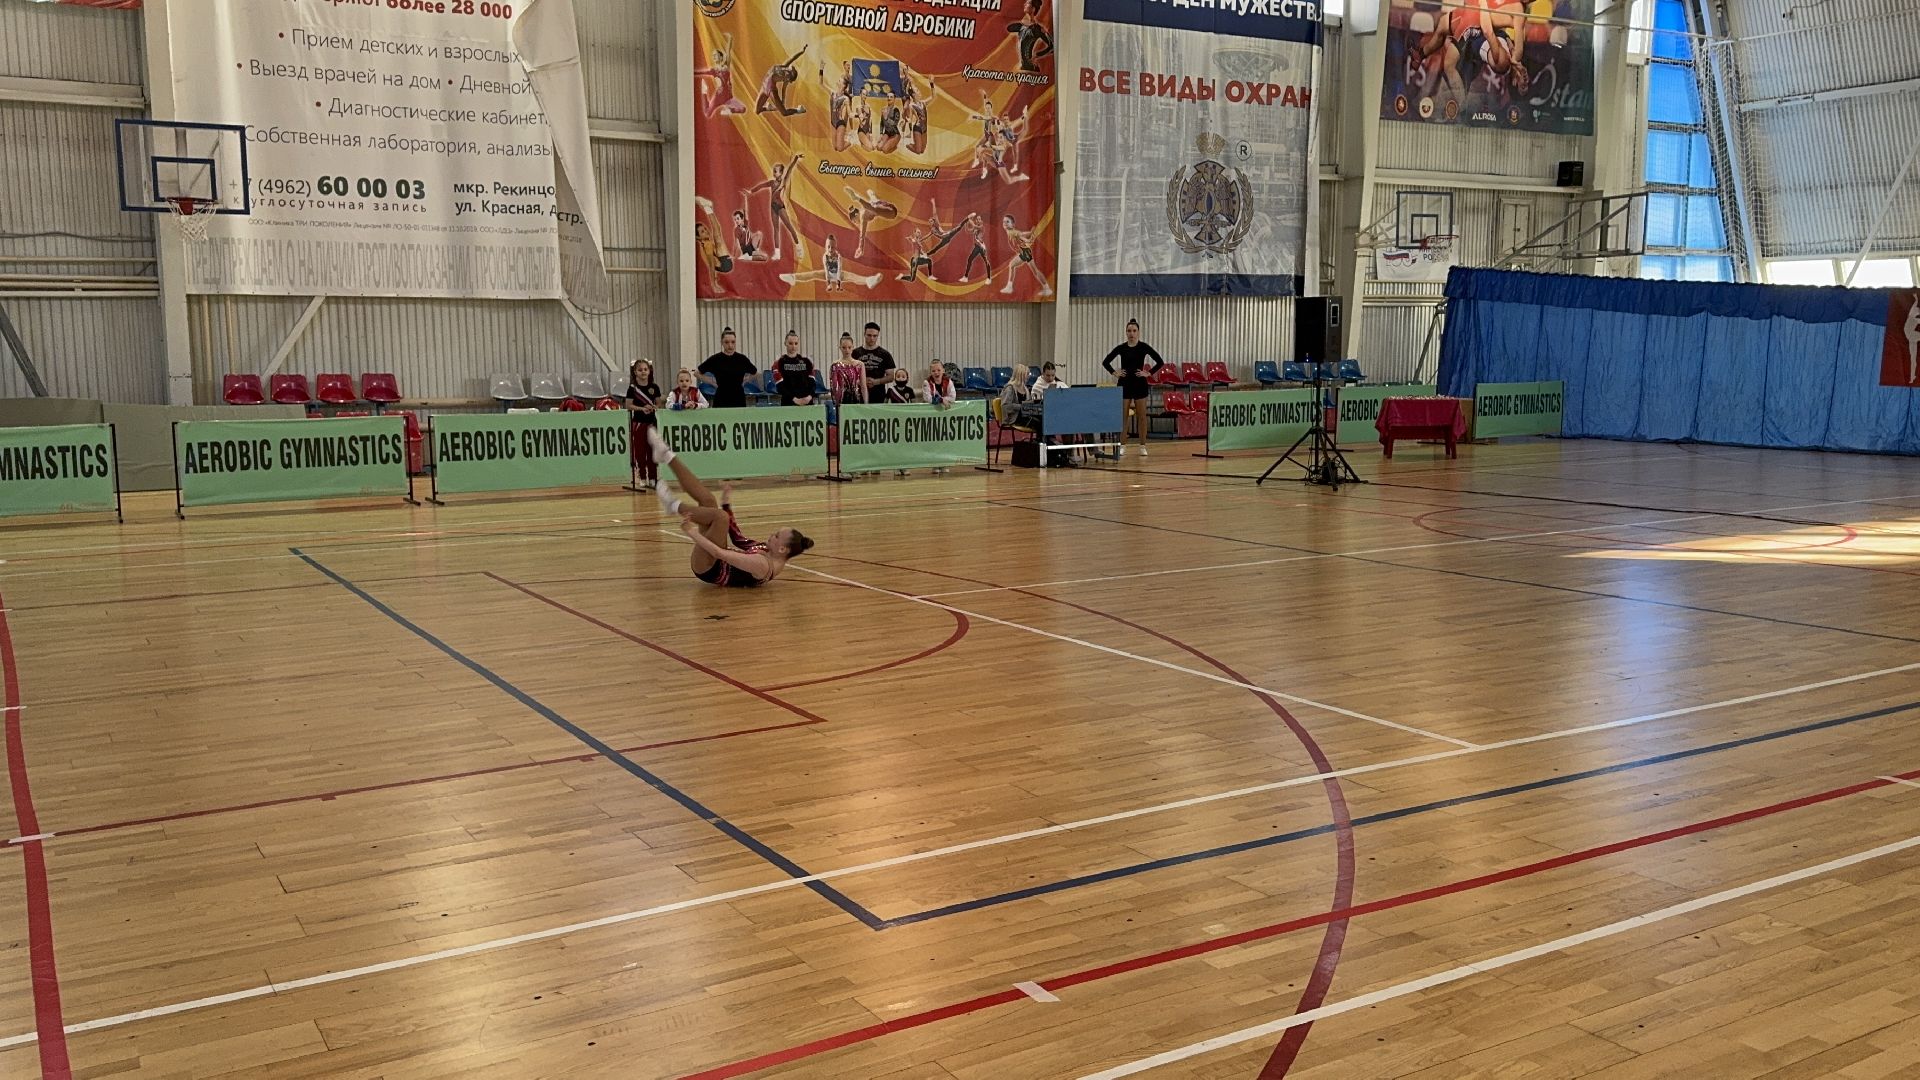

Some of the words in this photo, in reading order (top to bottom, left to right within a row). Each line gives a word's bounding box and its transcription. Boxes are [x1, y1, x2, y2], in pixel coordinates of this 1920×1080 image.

[452, 0, 475, 15] 28
[481, 1, 512, 19] 000
[782, 0, 887, 32] СПОРТИВНОЙ
[893, 12, 976, 40] АЭРОБИКИ
[1220, 0, 1322, 21] МУЖЕСТВ
[292, 28, 353, 50] Прием
[360, 39, 423, 57] детских
[428, 46, 438, 58] и
[444, 46, 520, 63] взрослых
[250, 59, 309, 81] Выезд
[315, 67, 377, 85] врачей
[383, 73, 403, 87] на
[409, 75, 441, 90] дом
[460, 75, 531, 95] Дневной
[963, 64, 1004, 81] Красота
[1006, 72, 1014, 82] и
[1015, 73, 1049, 86] грация
[1079, 67, 1131, 95] ВСЕ
[1139, 72, 1216, 104] ВИДЫ
[328, 97, 476, 123] Диагностические
[245, 125, 361, 148] Собственная
[368, 134, 480, 157] лаборатория,
[487, 142, 553, 157] анализы
[898, 165, 940, 179] сильнее!
[258, 178, 311, 197] (4962)
[317, 176, 349, 197] 60
[357, 177, 388, 199] 00
[395, 179, 426, 200] 03
[454, 183, 488, 198] мкр.
[494, 181, 556, 198] Рекинцо
[373, 201, 427, 213] запись
[455, 201, 476, 216] ул.
[482, 199, 544, 216] Красная,
[1211, 403, 1256, 428] AEROBIC
[1340, 399, 1379, 422] AEROBIC
[1478, 394, 1512, 416] AEROBIC
[1513, 392, 1561, 415] GYMNASTICS
[662, 423, 727, 453] AEROBIC
[733, 420, 824, 451] GYMNASTICS
[842, 417, 900, 445] AEROBIC
[905, 415, 984, 443] GYMNASTICS
[185, 438, 273, 474] AEROBIC
[280, 433, 403, 469] GYMNASTICS
[439, 429, 516, 462] AEROBIC
[521, 426, 627, 458] GYMNASTICS
